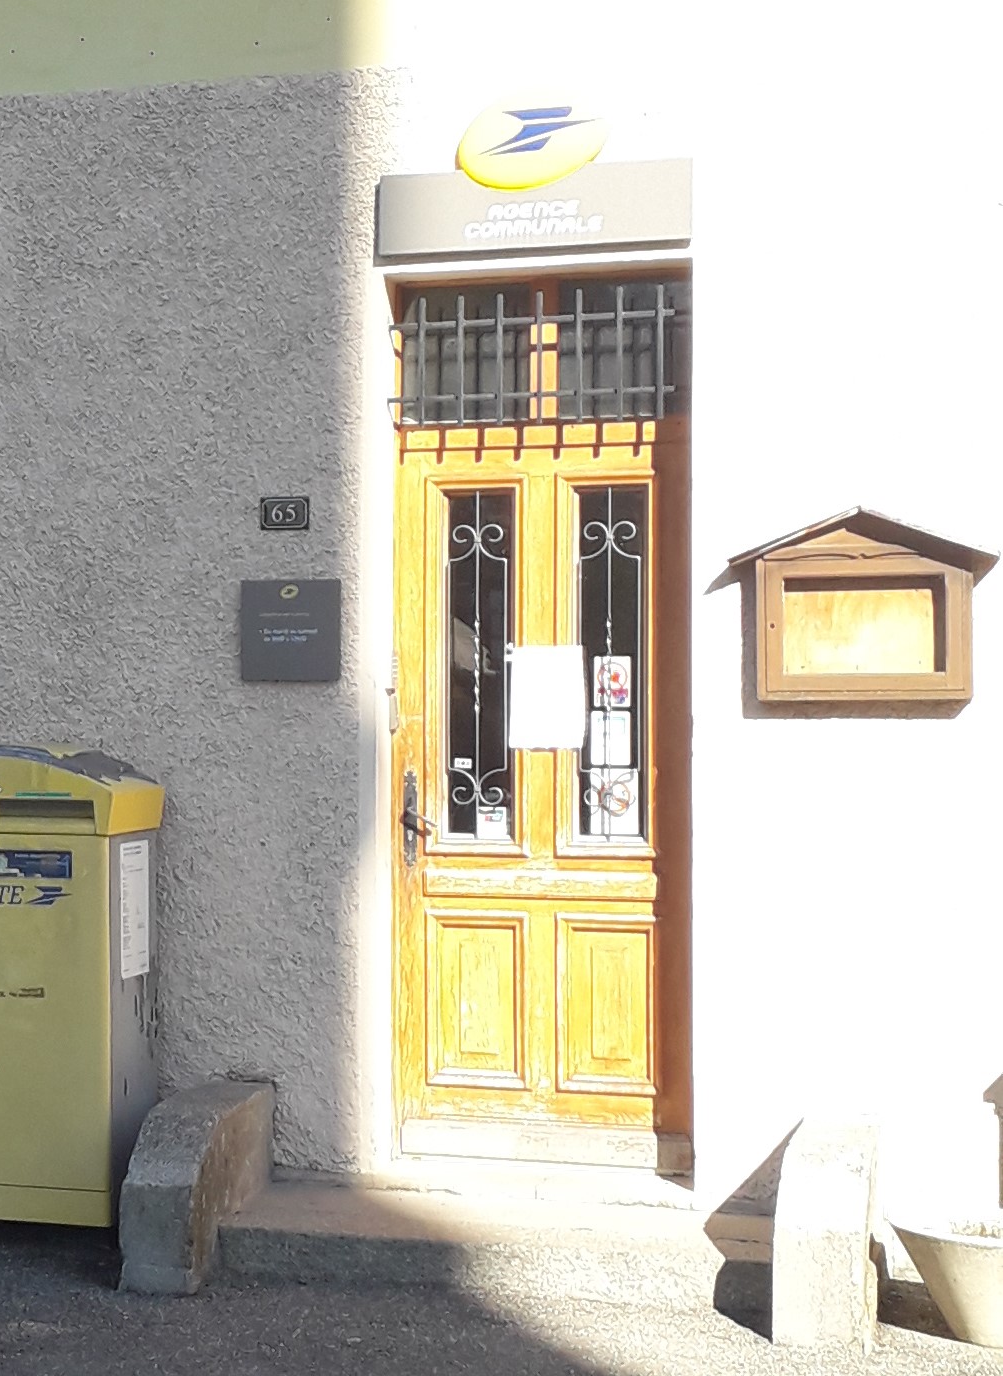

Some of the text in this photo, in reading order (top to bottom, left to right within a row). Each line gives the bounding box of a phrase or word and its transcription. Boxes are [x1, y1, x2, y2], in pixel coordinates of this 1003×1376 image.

[488, 198, 582, 220] AGENCE
[464, 214, 604, 240] COMMUNALE
[271, 503, 297, 523] 65
